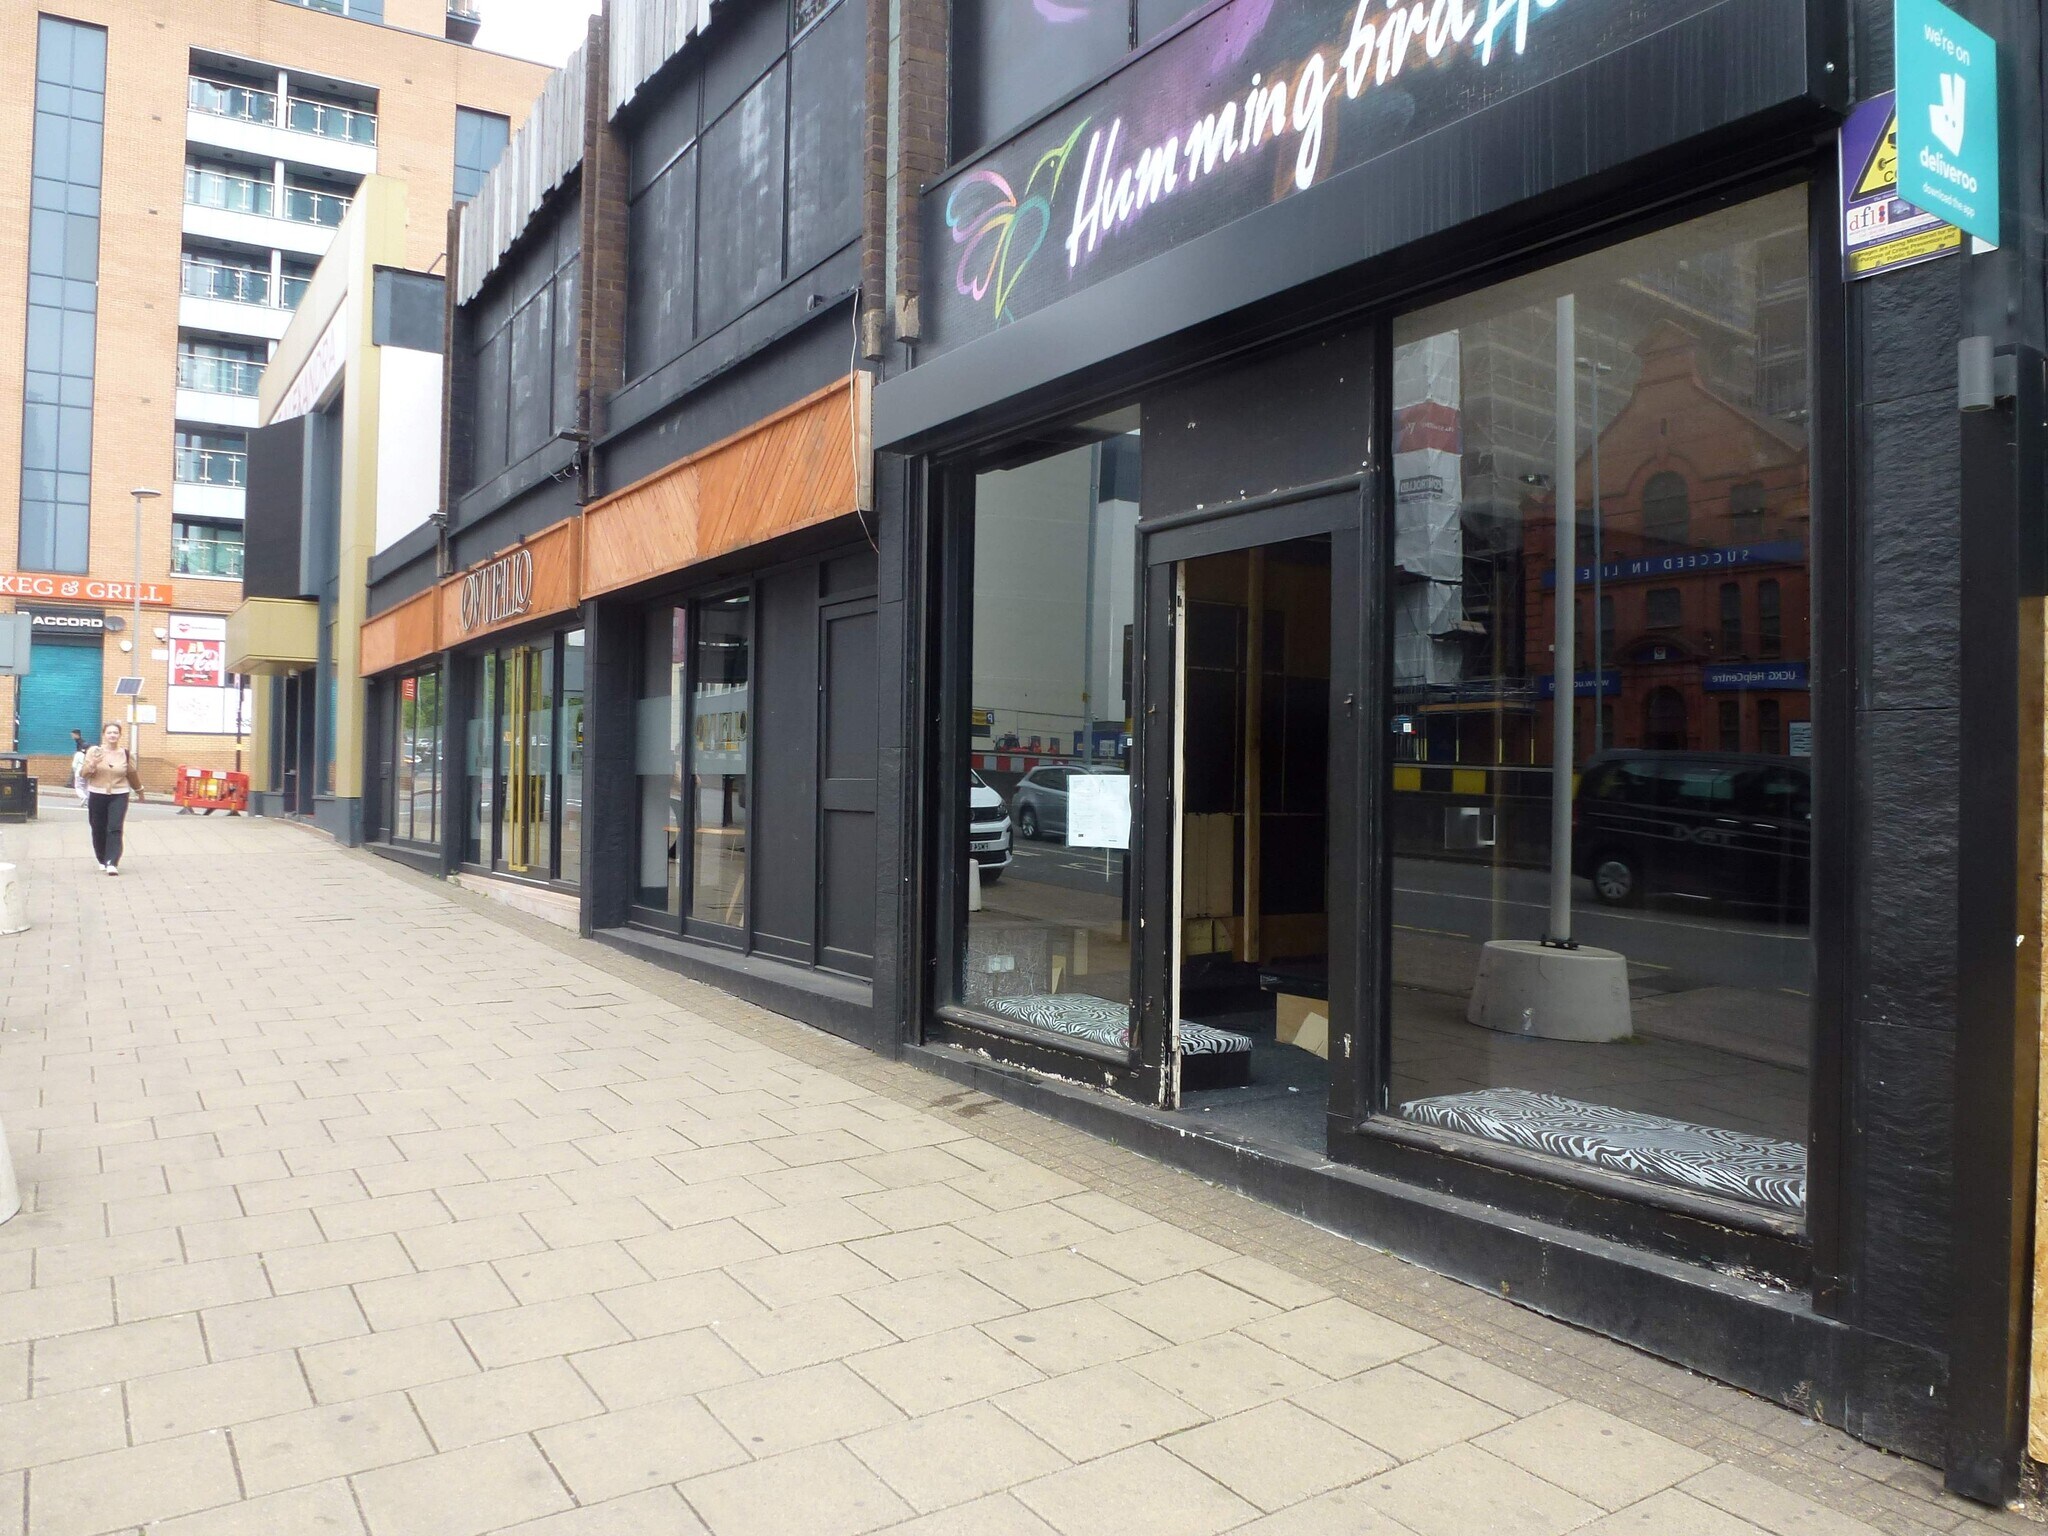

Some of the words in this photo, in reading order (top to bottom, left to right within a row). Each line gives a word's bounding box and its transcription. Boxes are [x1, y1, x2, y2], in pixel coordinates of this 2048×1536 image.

[1923, 23, 1955, 55] we're
[1955, 46, 1970, 67] on
[1920, 145, 1977, 193] deliveroo
[0, 576, 54, 595] KEG
[60, 580, 80, 597] &
[32, 616, 104, 628] ACCORD
